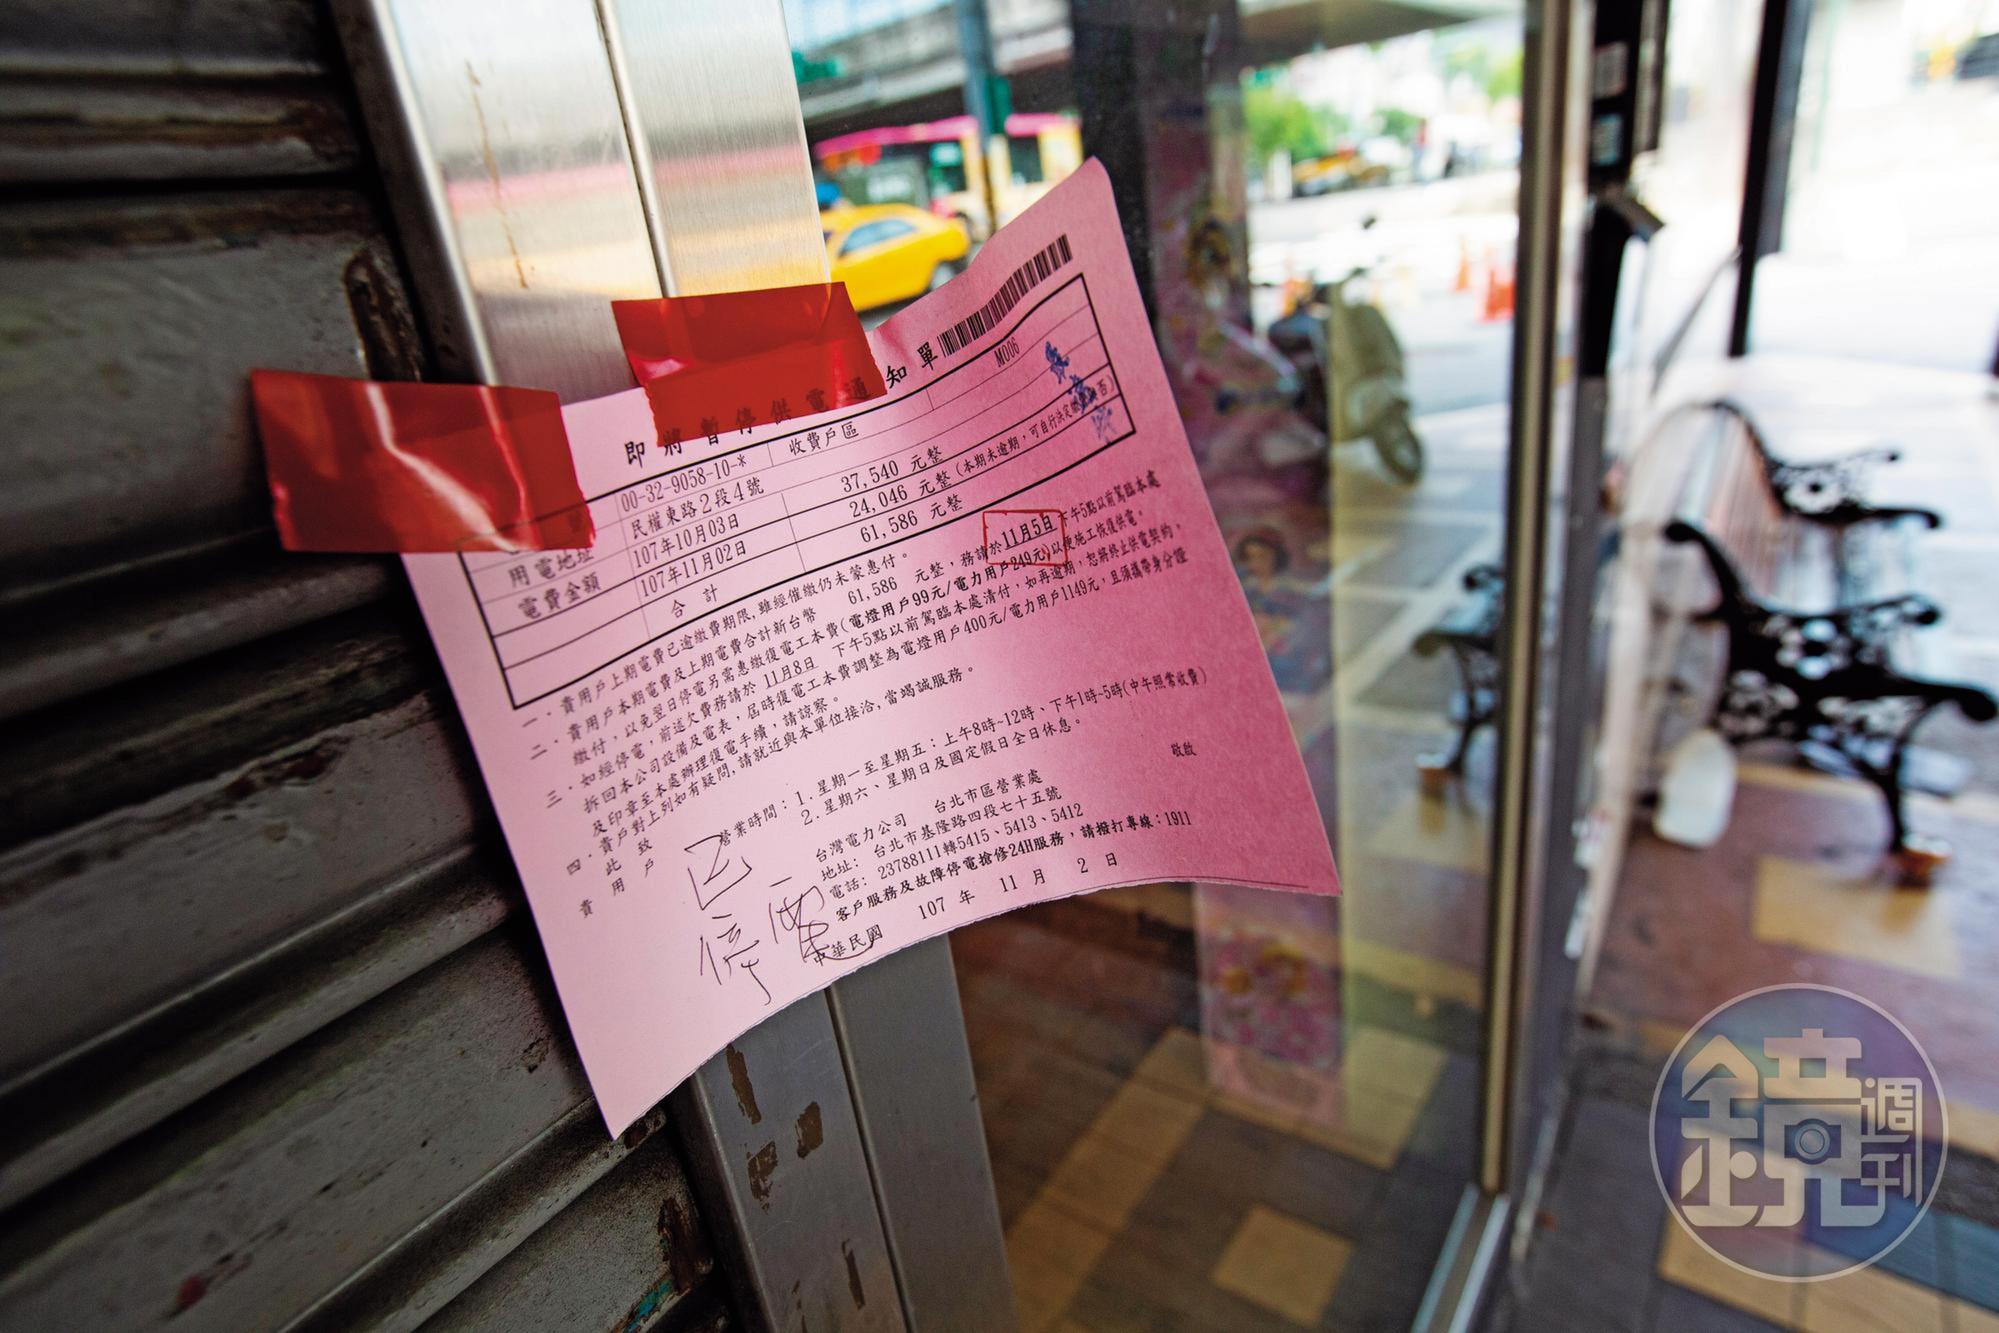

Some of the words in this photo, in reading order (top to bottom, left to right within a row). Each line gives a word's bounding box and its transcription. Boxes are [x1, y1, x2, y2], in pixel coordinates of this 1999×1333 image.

[787, 420, 859, 456] 收費戶區
[994, 341, 1021, 367] M006
[508, 545, 594, 589] 用電地址
[629, 474, 765, 540] 民權東路2段4號
[517, 571, 601, 619] 電費金額
[631, 511, 740, 568] 107年10月03日
[840, 459, 900, 495] 37,540
[907, 444, 944, 472] 元整
[639, 539, 748, 597] 107年11月02日
[848, 483, 908, 519] 24,046
[859, 509, 919, 544] 61,586
[928, 492, 964, 519] 元整
[847, 575, 898, 605] 61,586
[762, 655, 816, 688] 11月8日
[813, 812, 908, 864] 台灣電力公司
[932, 766, 1043, 815] 台北市區營業處
[872, 784, 1062, 859] 台北市基隆路四段七十五號
[917, 896, 947, 920] 107
